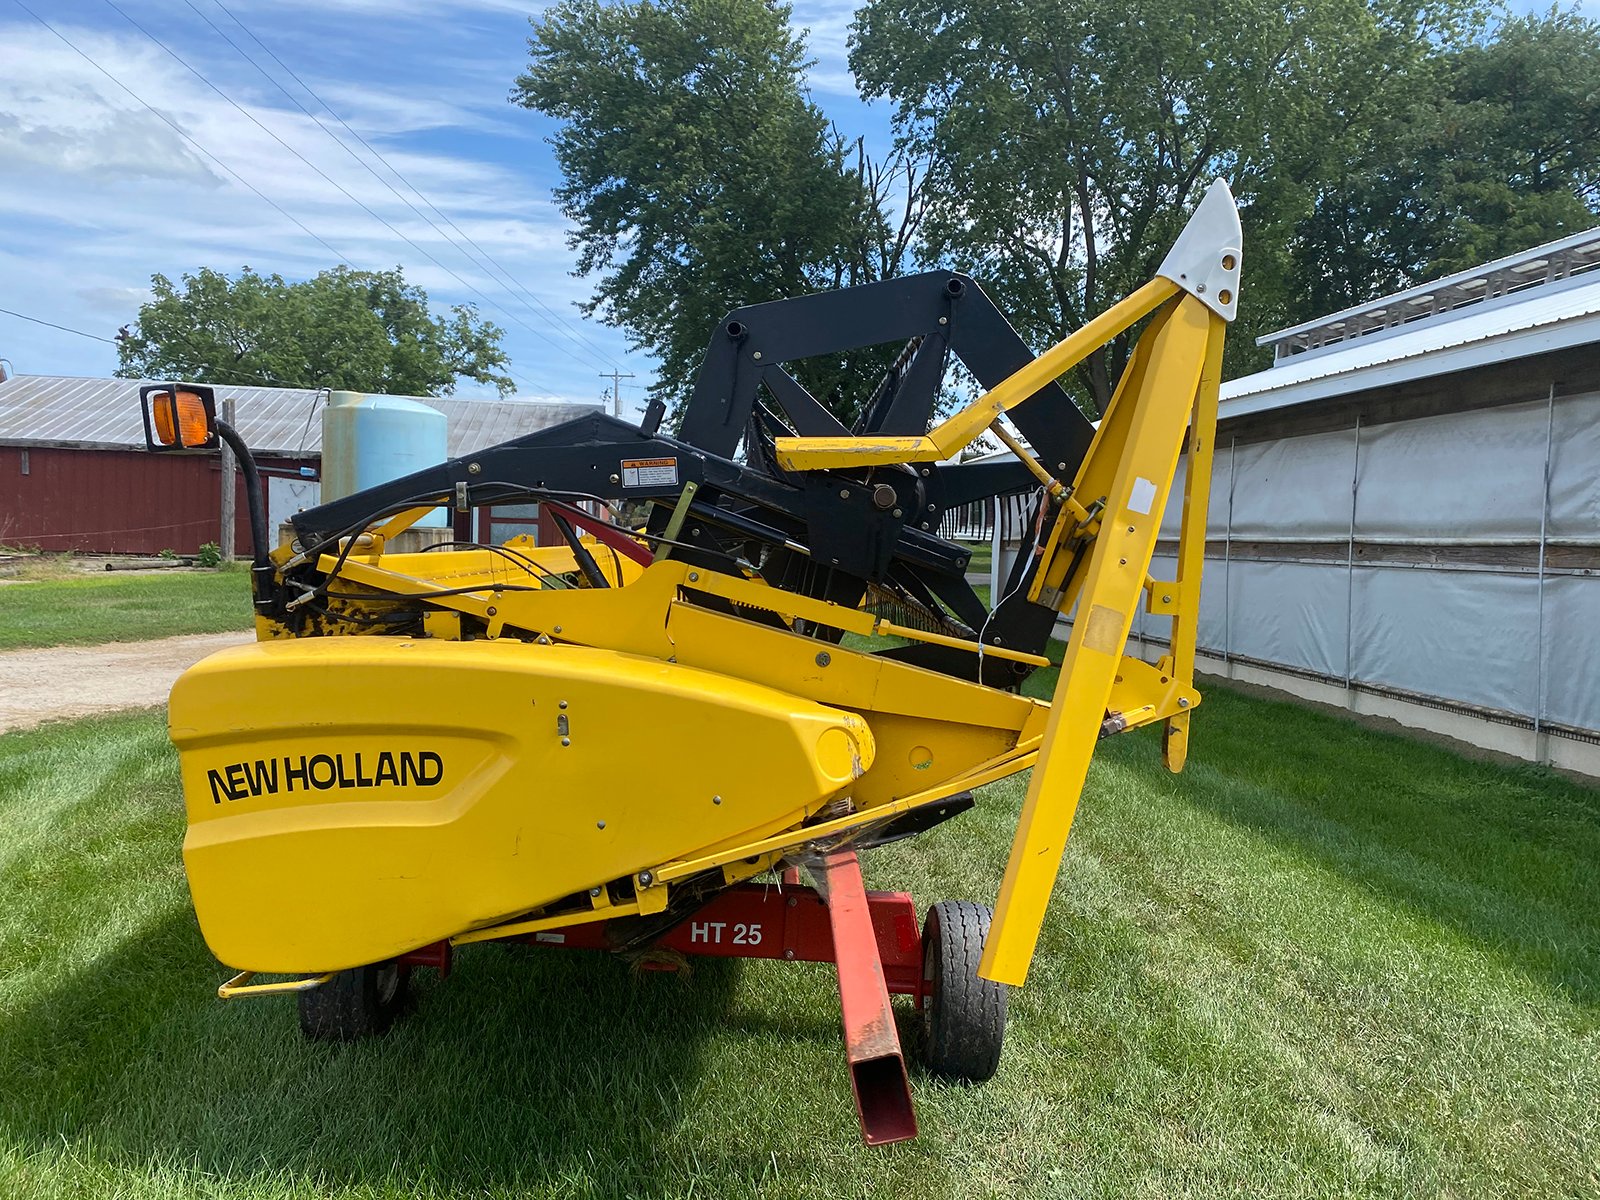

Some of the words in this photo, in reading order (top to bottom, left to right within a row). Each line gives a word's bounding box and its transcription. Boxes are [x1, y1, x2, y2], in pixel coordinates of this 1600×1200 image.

[207, 758, 279, 804] NEW
[284, 751, 443, 792] HOLLAND
[691, 922, 726, 943] HT
[733, 923, 762, 945] 25
